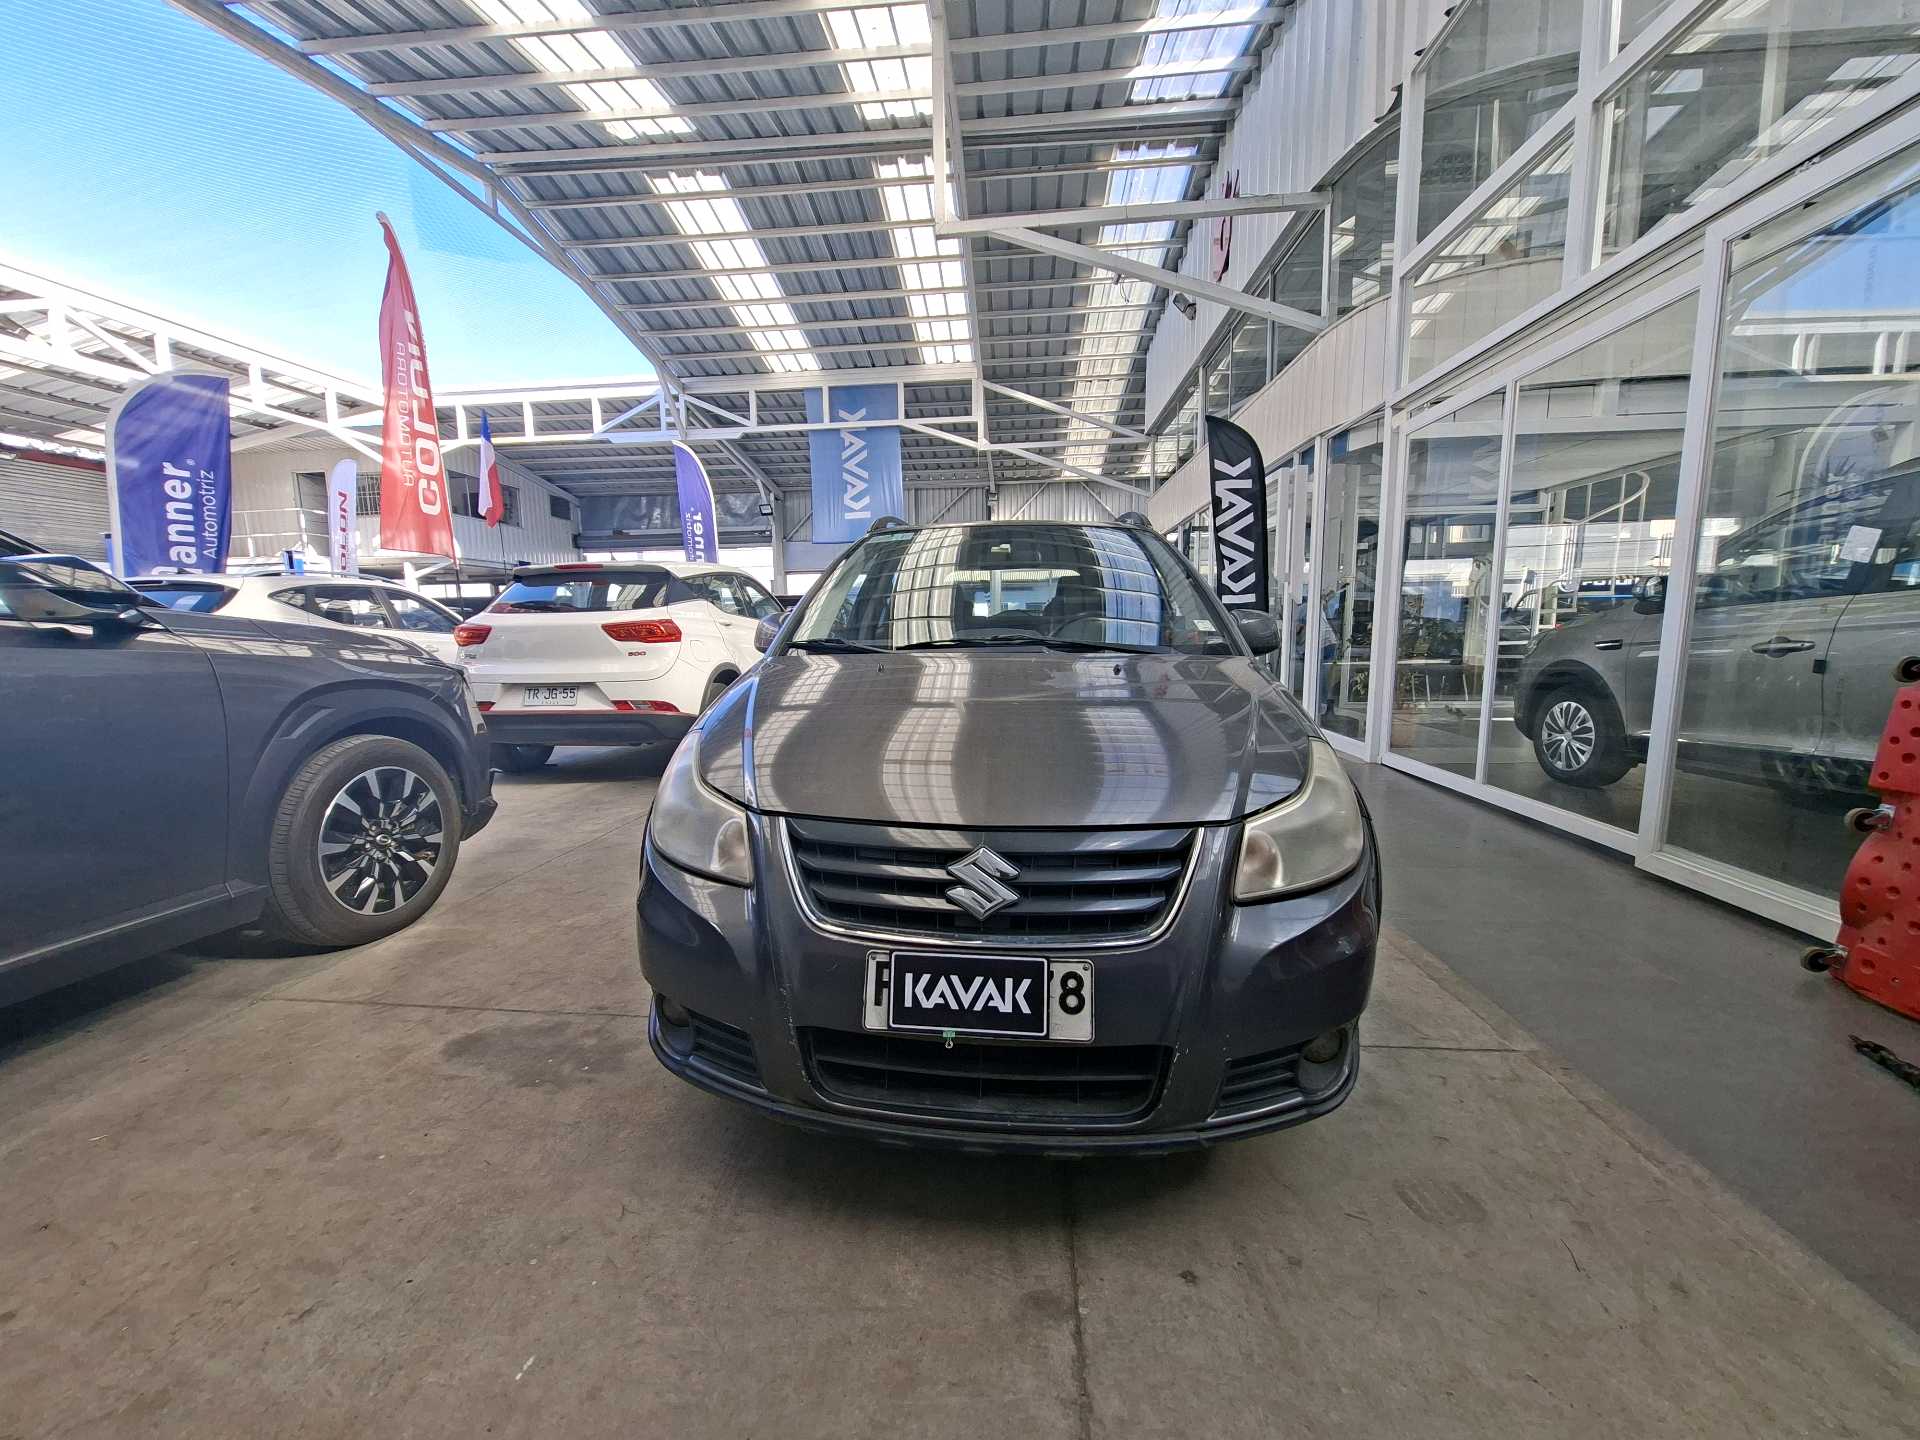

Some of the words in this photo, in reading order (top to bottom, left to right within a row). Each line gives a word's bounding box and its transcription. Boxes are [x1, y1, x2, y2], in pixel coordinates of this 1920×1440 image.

[838, 408, 871, 519] KAVAK
[196, 470, 218, 559] Automotriz
[1213, 457, 1257, 604] KAVAK
[904, 972, 1033, 1015] KAVAK
[1051, 970, 1086, 1016] 8
